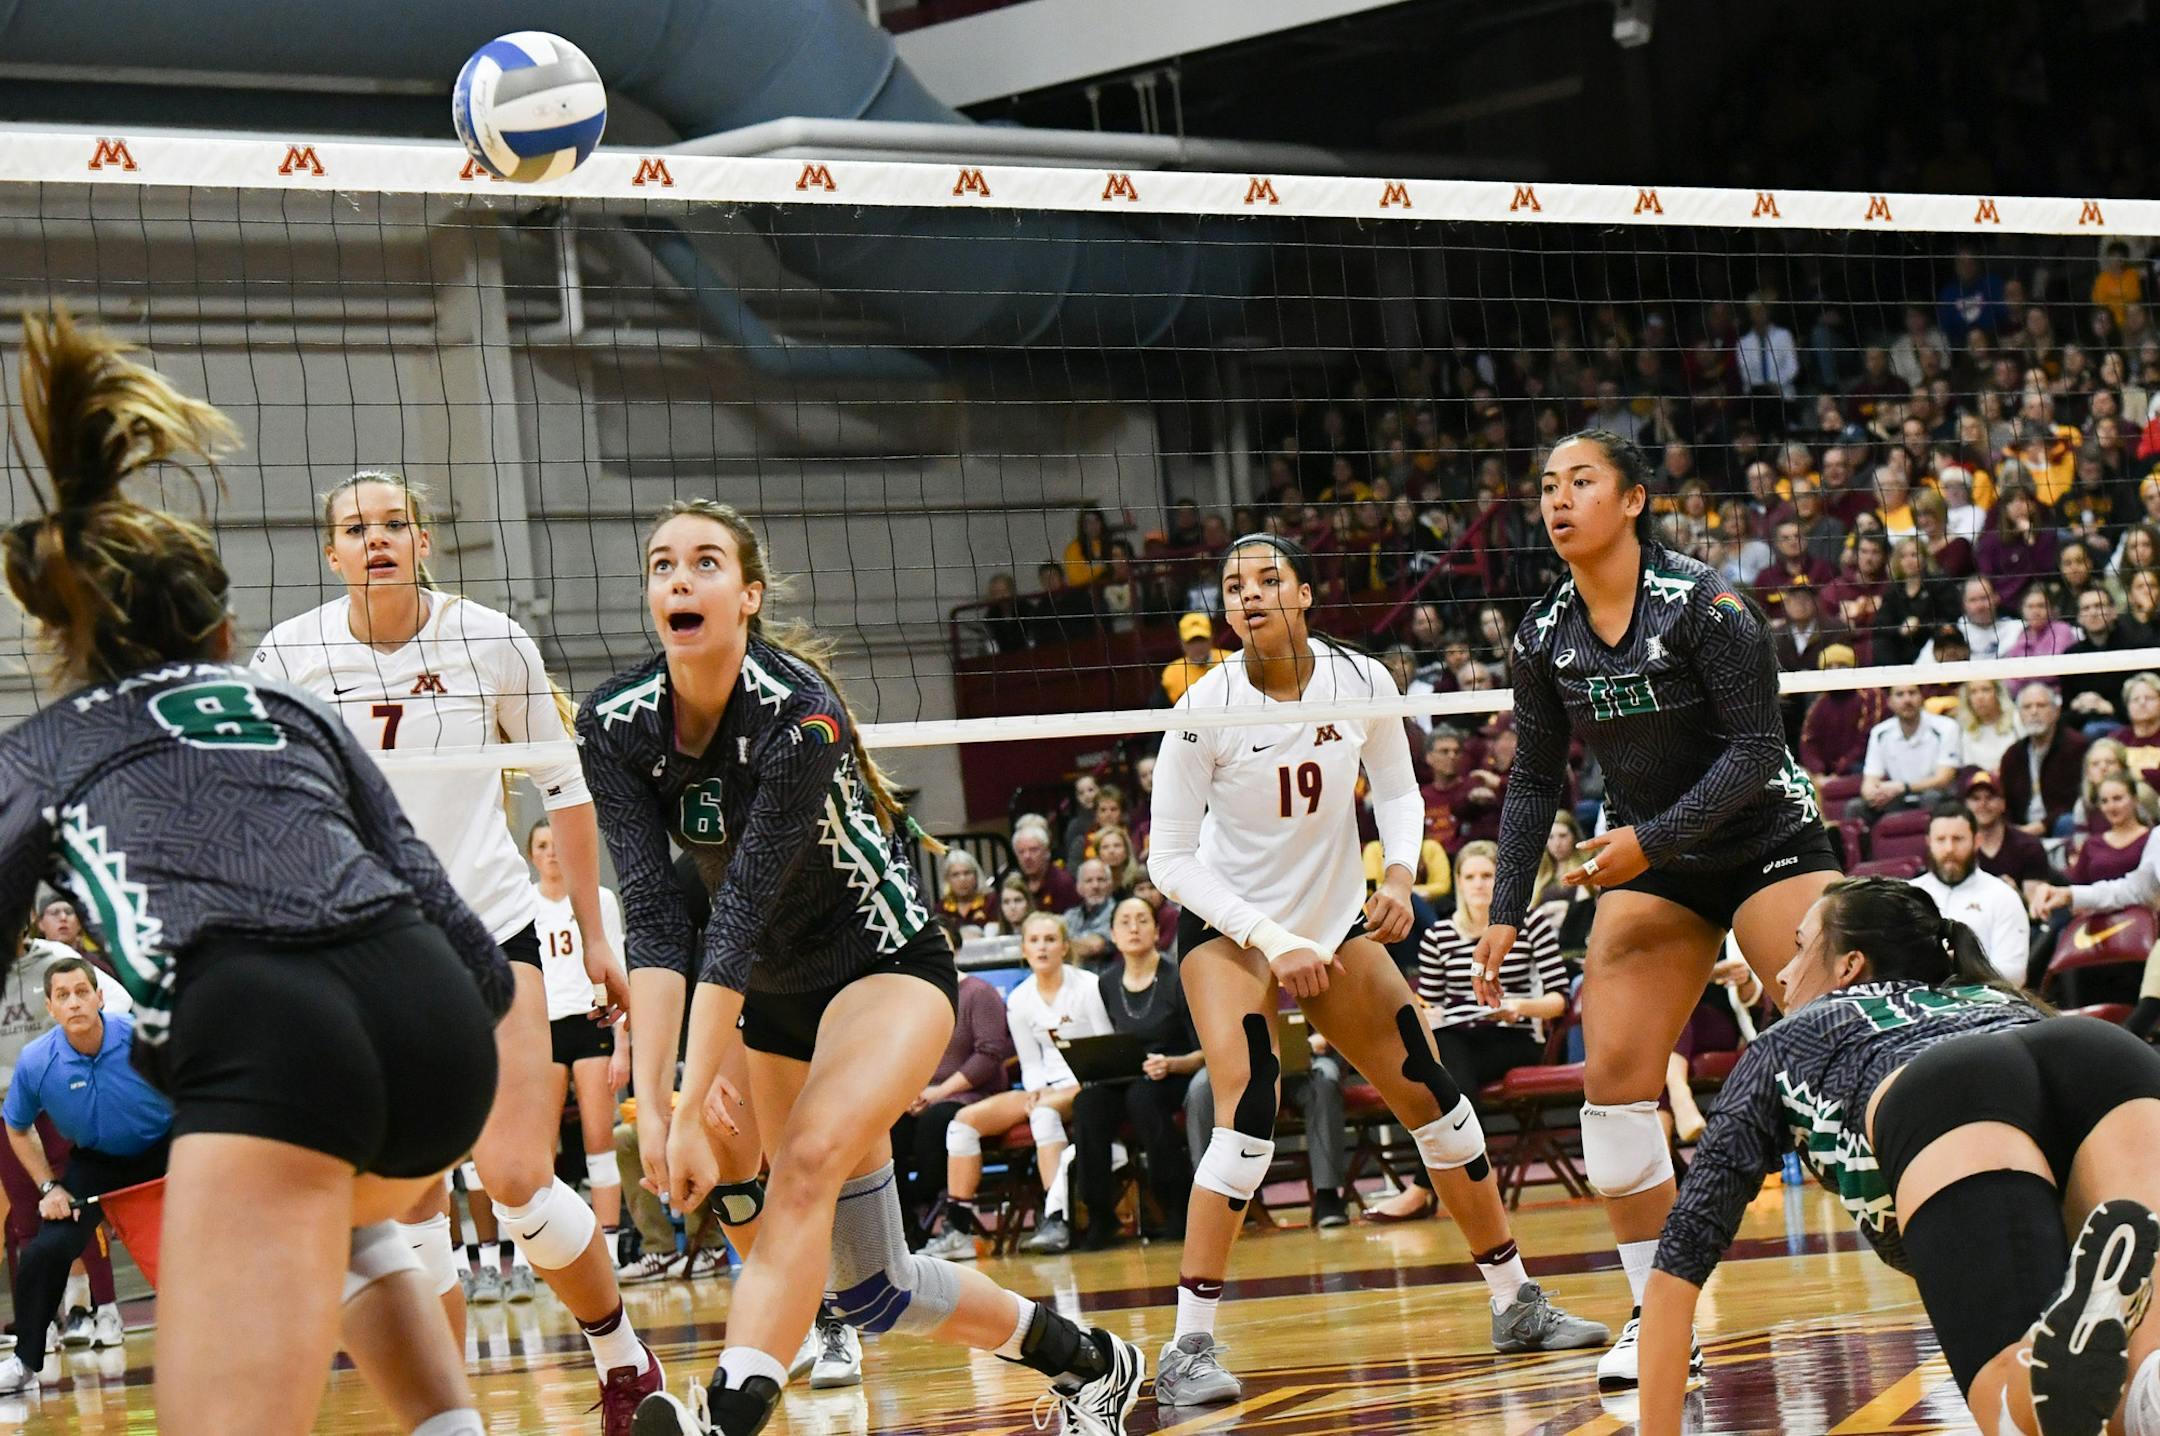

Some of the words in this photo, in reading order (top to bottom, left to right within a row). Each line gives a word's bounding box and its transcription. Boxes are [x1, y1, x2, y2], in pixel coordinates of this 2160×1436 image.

[88, 137, 137, 171] M
[278, 144, 325, 176] M
[632, 158, 673, 187] M
[796, 163, 836, 193] M
[952, 168, 990, 197] M
[1102, 173, 1138, 202] M
[1244, 177, 1280, 205] M
[1379, 181, 1412, 209] M
[1509, 185, 1542, 213] M
[1634, 190, 1664, 216] M
[1752, 191, 1781, 220] M
[1865, 195, 1893, 223] M
[1974, 198, 2001, 225] M
[2079, 201, 2105, 226] M
[410, 673, 448, 696] M
[1585, 673, 1660, 721] 10
[148, 679, 288, 750] 8
[371, 704, 404, 750] 7
[1314, 723, 1344, 747] M
[1279, 761, 1323, 818] 19
[680, 777, 728, 845] 6
[549, 930, 574, 958] 13
